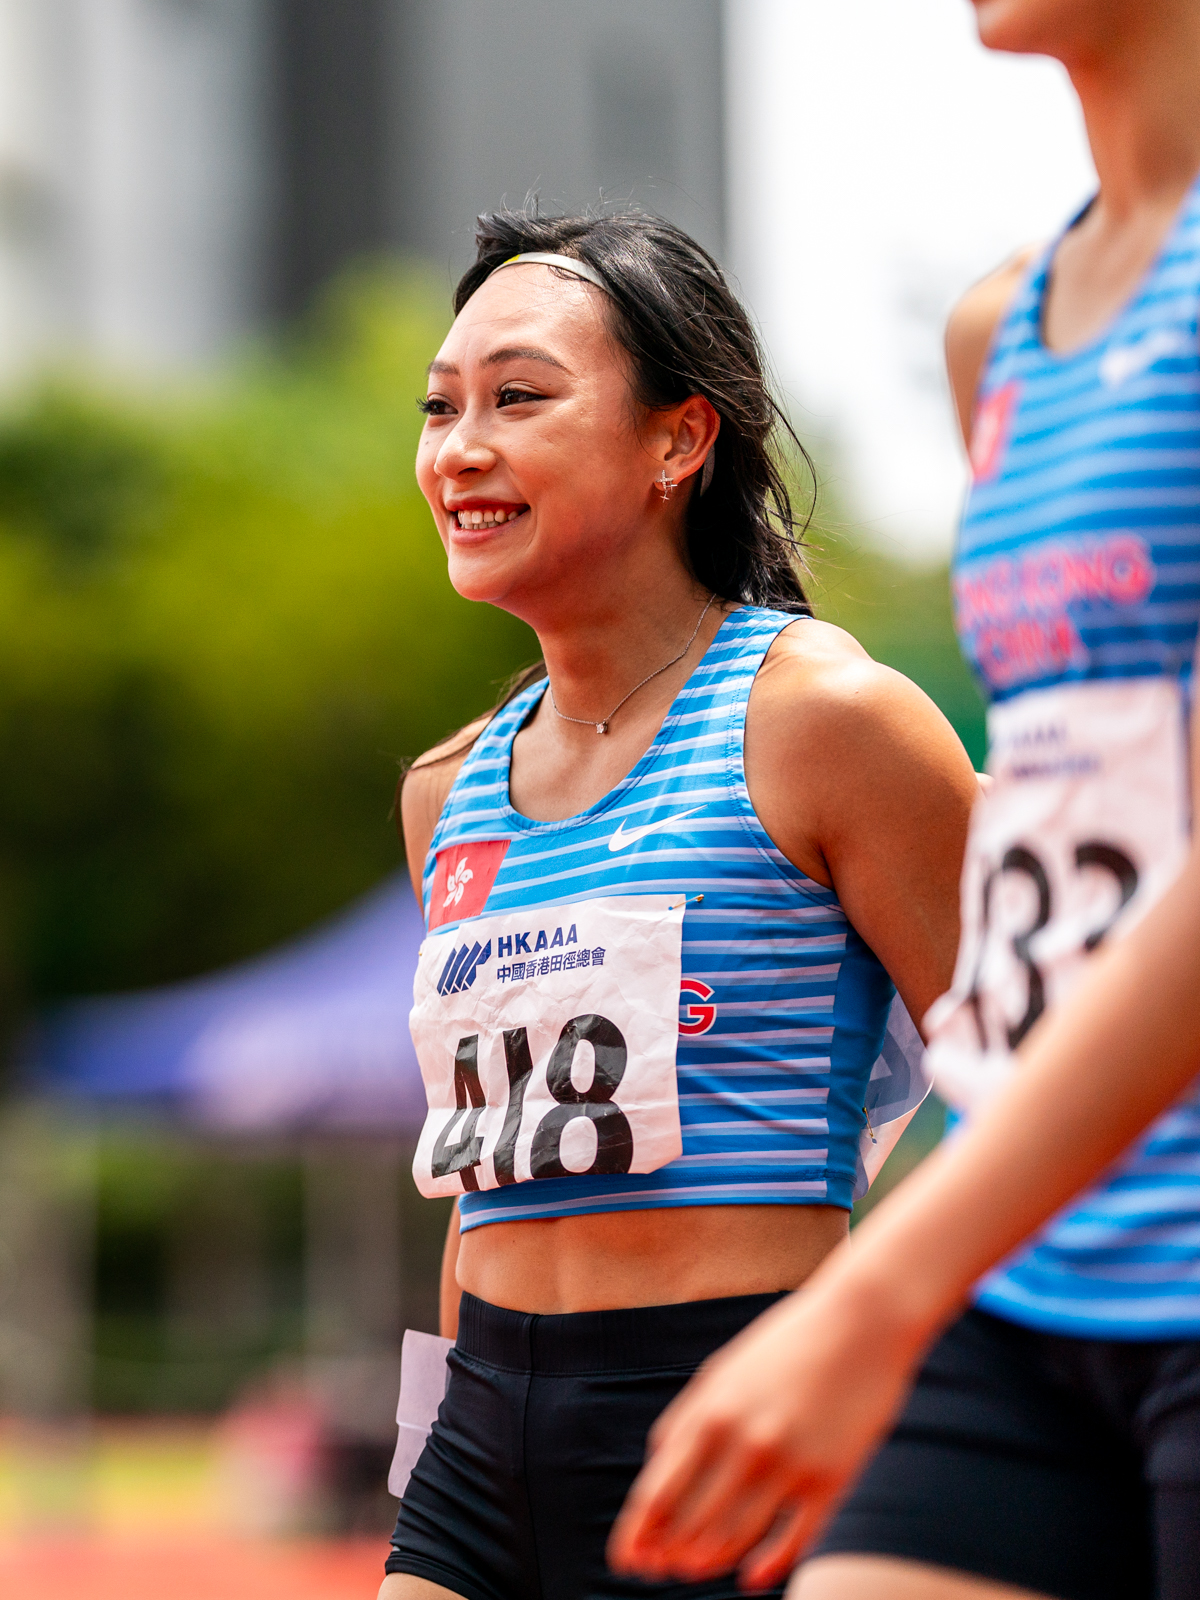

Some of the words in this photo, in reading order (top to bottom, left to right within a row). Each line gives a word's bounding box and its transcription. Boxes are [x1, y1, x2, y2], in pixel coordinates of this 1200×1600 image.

[497, 923, 578, 959] HKAAA
[496, 946, 606, 984] 中國香港田徑總會
[432, 1013, 634, 1193] 418
